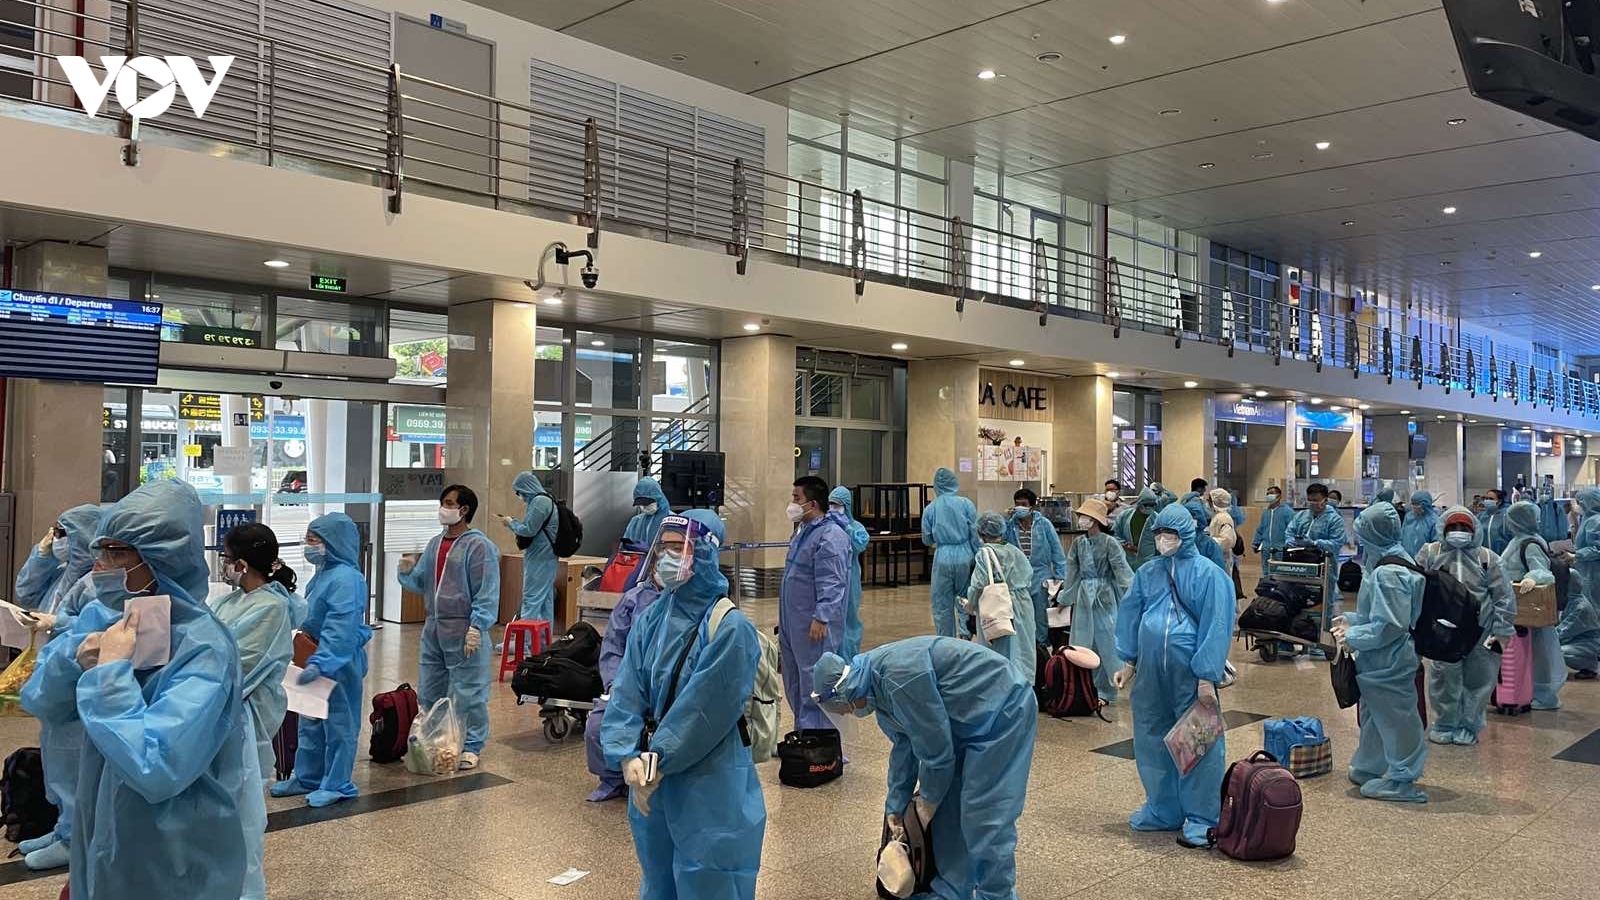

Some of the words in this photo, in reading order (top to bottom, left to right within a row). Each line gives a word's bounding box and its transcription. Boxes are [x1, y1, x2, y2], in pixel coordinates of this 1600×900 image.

[320, 277, 338, 285] EXIT
[12, 293, 47, 305] Chuyến
[48, 296, 57, 304] đi
[65, 298, 113, 309] Departures
[142, 306, 160, 314] 16:37
[1002, 384, 1047, 410] CAFE
